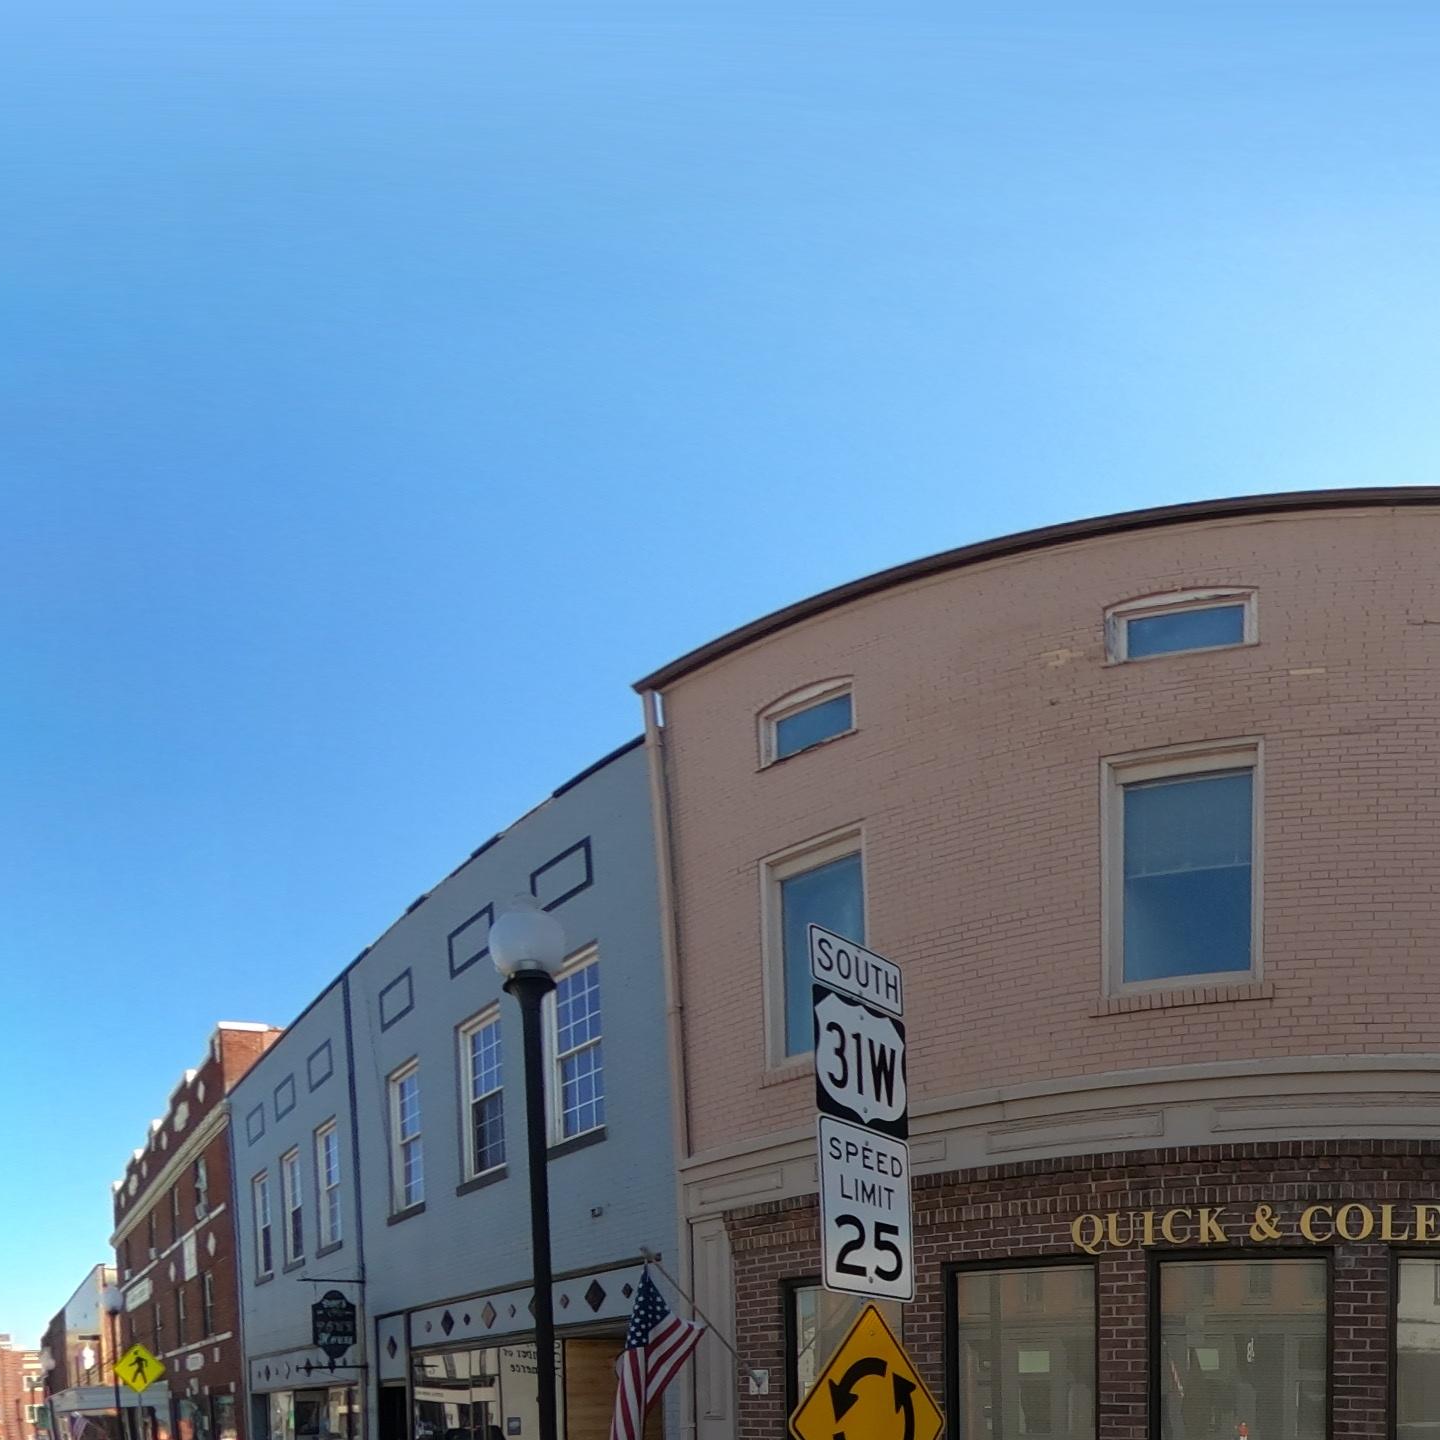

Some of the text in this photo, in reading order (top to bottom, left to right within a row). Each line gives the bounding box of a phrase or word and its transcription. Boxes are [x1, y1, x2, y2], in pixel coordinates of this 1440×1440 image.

[816, 937, 900, 1004] SOUTH
[825, 1021, 896, 1107] 31W
[829, 1136, 903, 1179] SPEED
[840, 1174, 895, 1210] LIMIT
[833, 1214, 904, 1282] 25
[1071, 1207, 1229, 1255] QUICK
[1249, 1204, 1283, 1242] &
